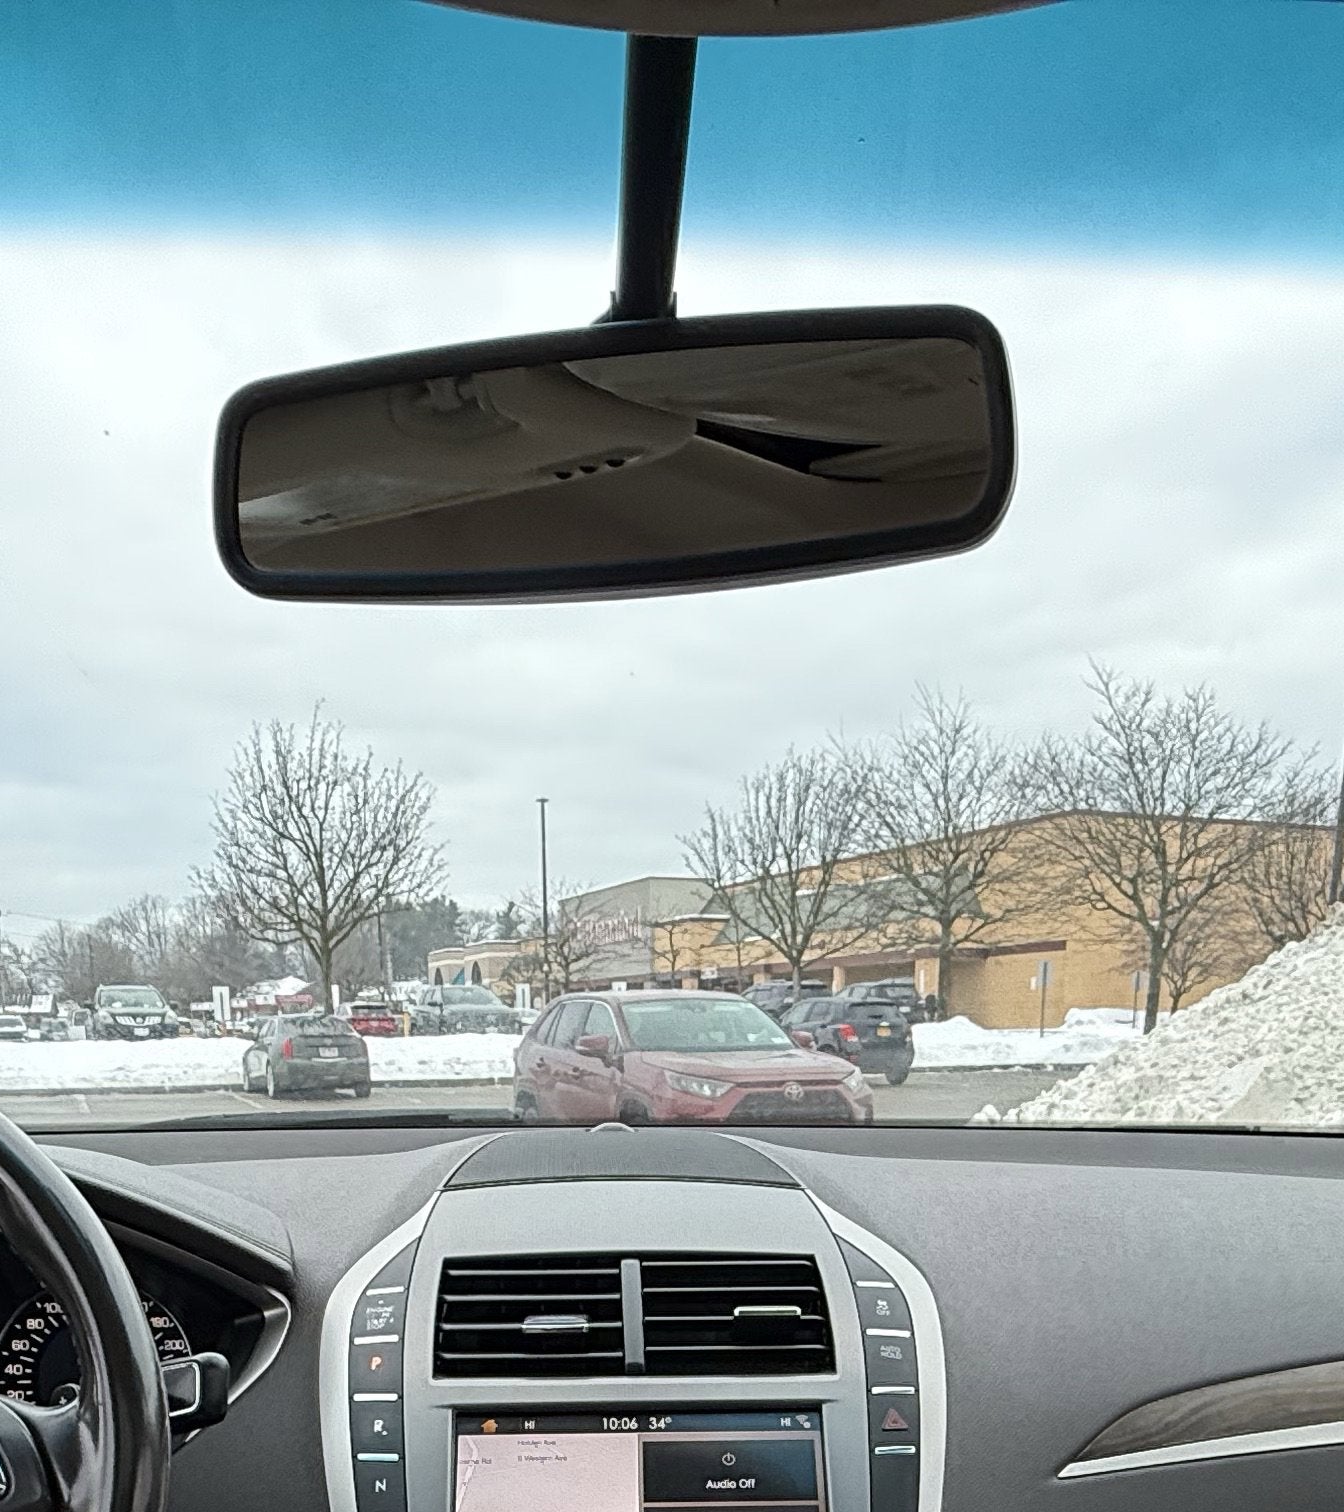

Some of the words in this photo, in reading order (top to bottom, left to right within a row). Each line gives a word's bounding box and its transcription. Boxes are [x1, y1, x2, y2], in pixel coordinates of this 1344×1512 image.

[26, 1319, 45, 1330] 80
[11, 1340, 30, 1351] 60
[164, 1340, 186, 1350] 200
[370, 1356, 382, 1370] P
[4, 1364, 24, 1375] 40
[6, 1390, 25, 1401] 20
[374, 1419, 385, 1433] R
[602, 1417, 638, 1431] 10:06
[375, 1478, 387, 1493] N
[706, 1478, 736, 1489] Audio
[739, 1478, 755, 1489] Off
